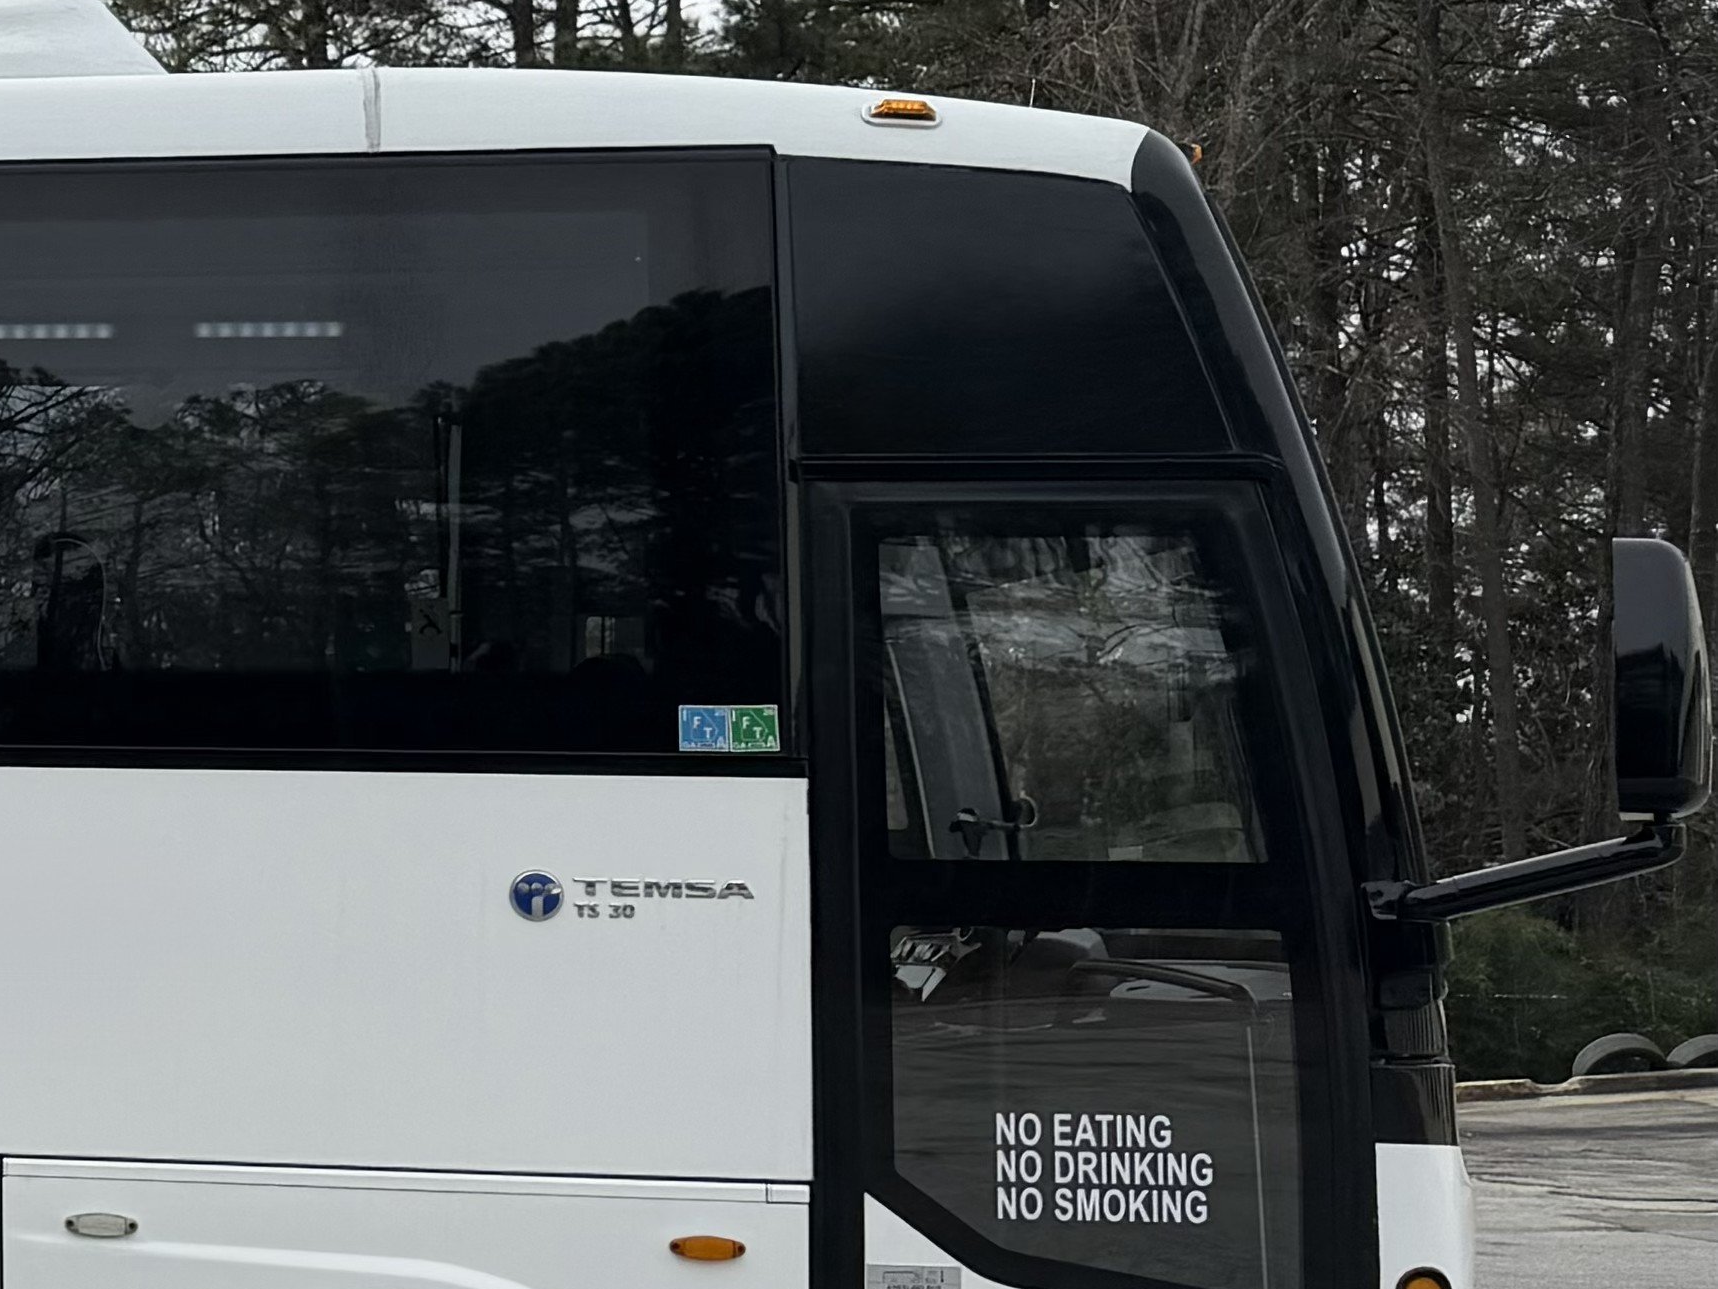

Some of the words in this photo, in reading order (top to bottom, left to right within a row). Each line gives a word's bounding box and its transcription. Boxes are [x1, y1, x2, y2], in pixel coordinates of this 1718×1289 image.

[572, 877, 755, 899] TEMSA
[573, 901, 600, 919] TS
[608, 903, 635, 919] 30
[995, 1112, 1042, 1146] NO
[1053, 1113, 1172, 1148] EATING
[996, 1149, 1042, 1183] NO
[1054, 1150, 1213, 1186] DRINKING
[996, 1186, 1043, 1220] NO
[1054, 1187, 1208, 1224] SMOKING
